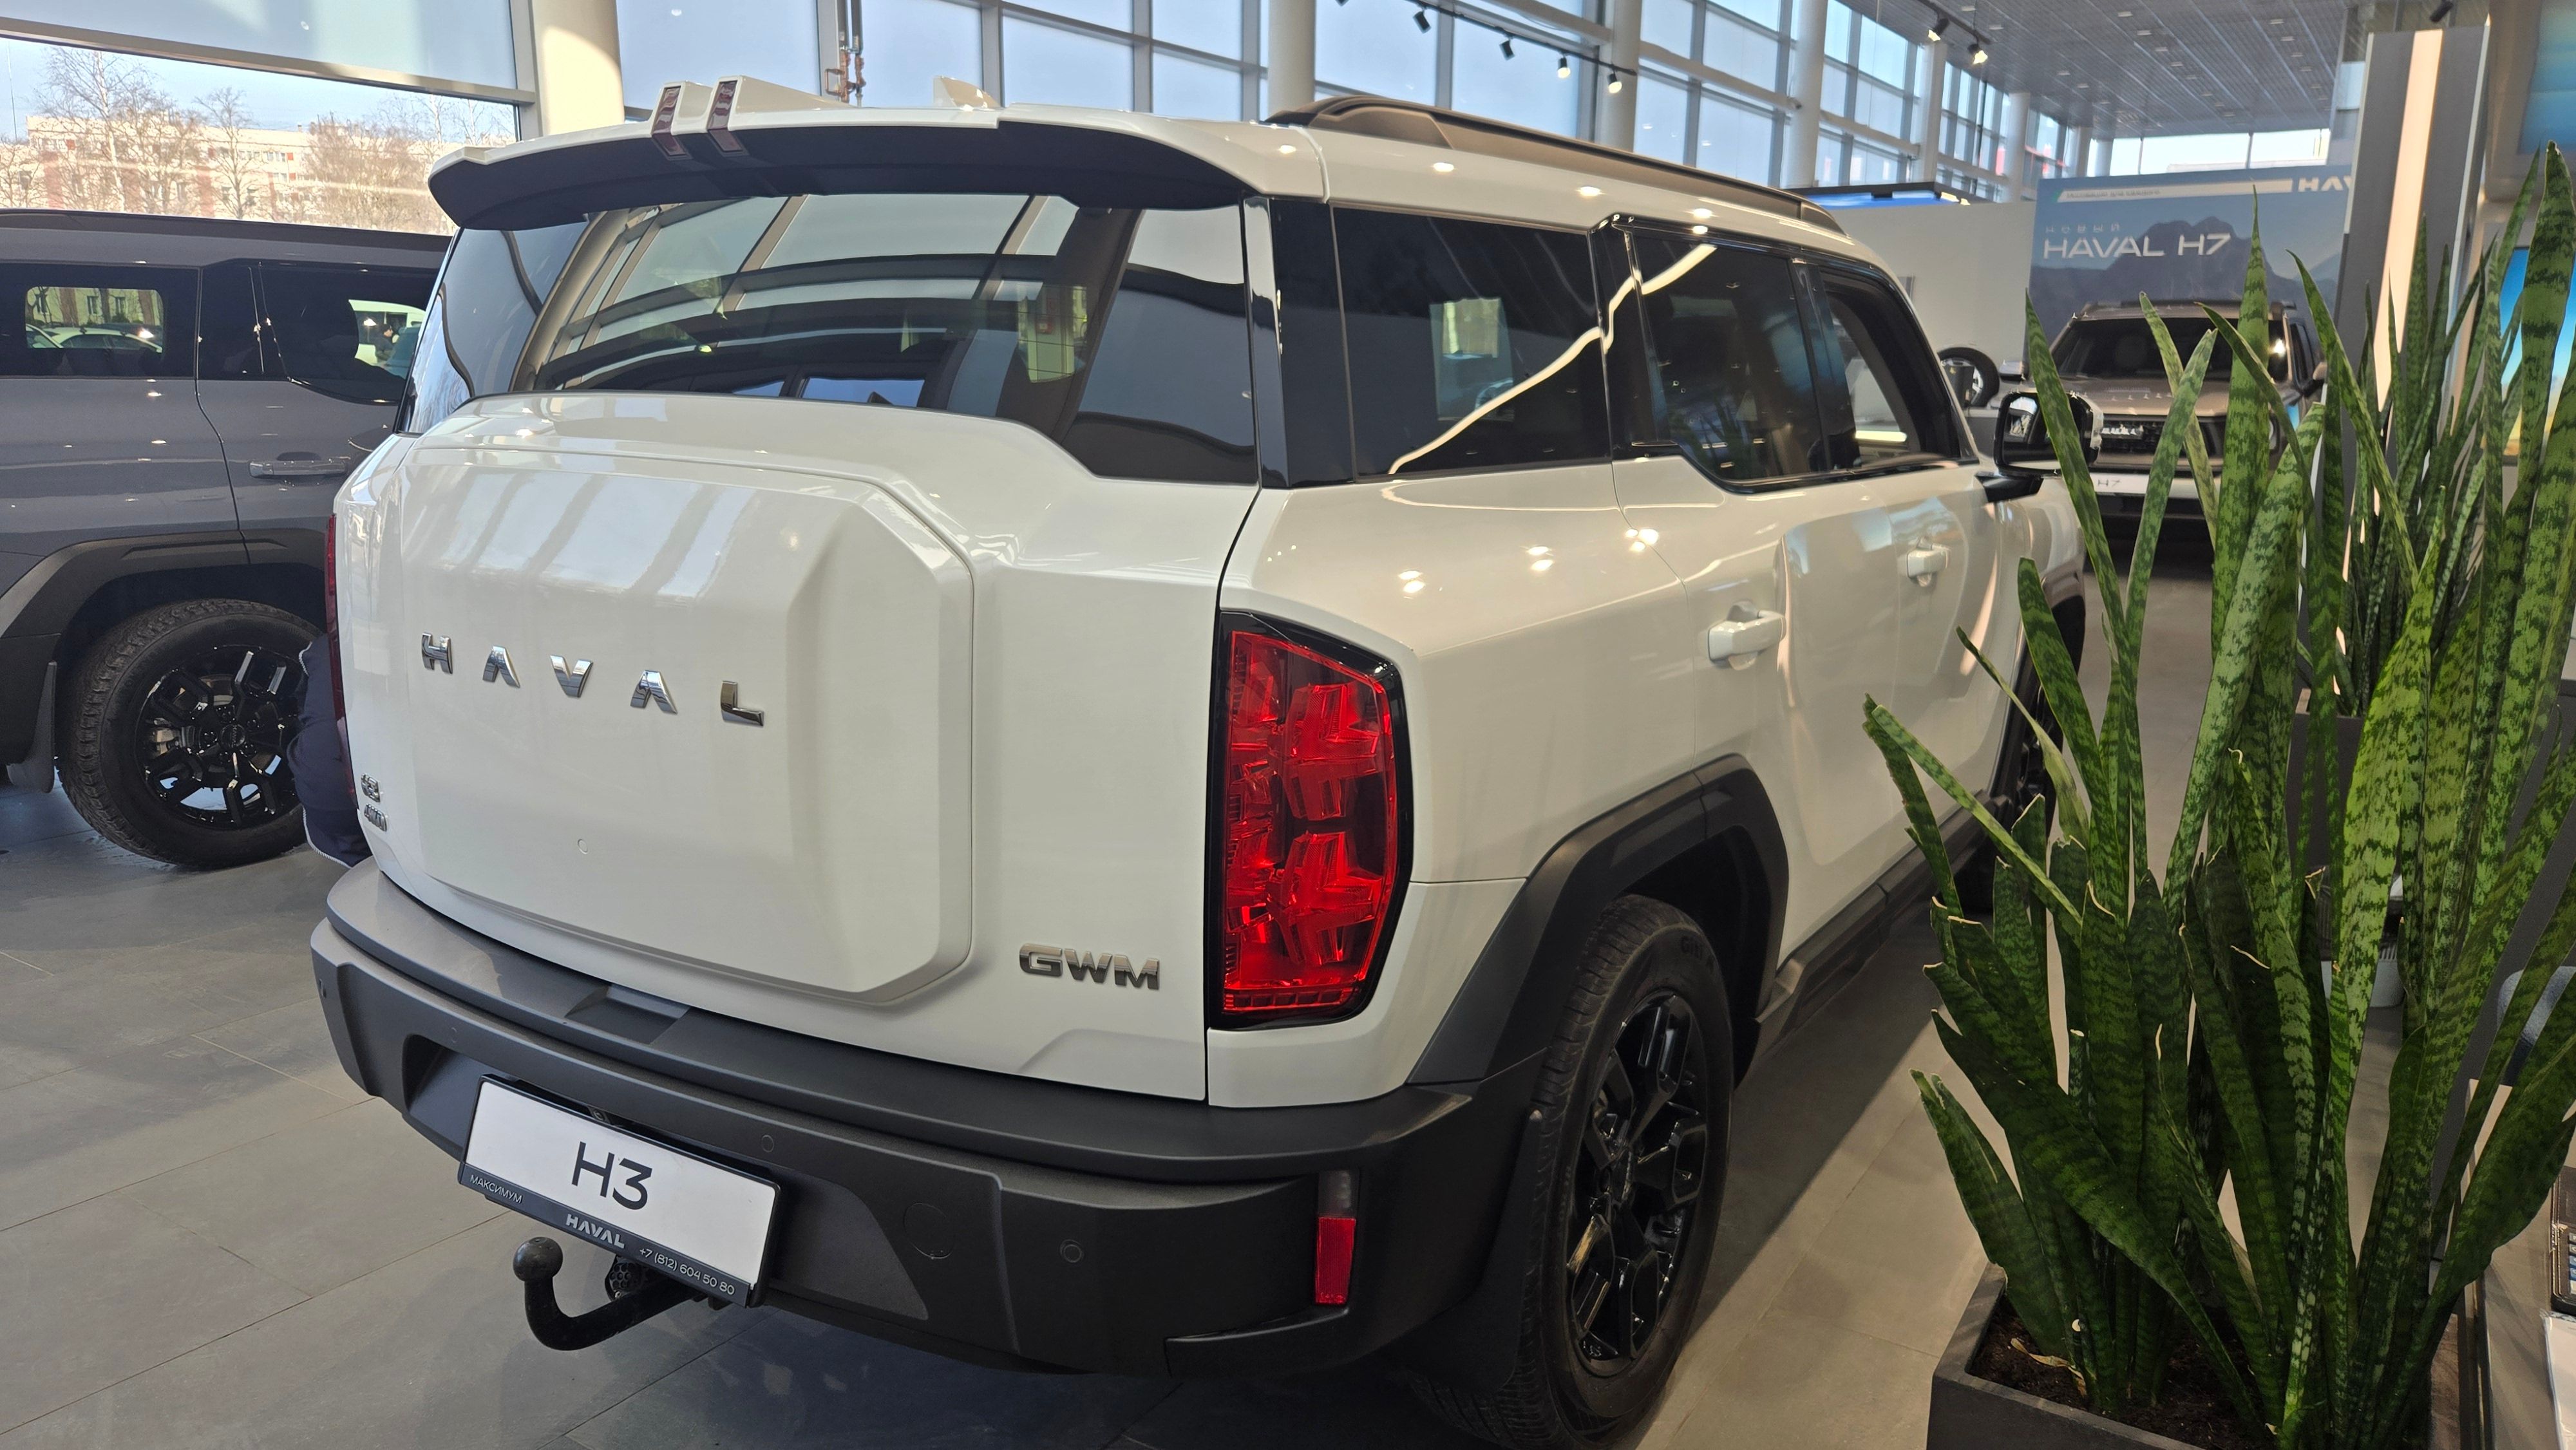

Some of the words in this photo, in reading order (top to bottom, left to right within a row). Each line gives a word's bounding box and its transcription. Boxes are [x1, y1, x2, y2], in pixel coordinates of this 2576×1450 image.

[2043, 235, 2165, 259] HAVAL
[2177, 232, 2231, 256] H7
[2098, 478, 2121, 487] H7
[421, 632, 765, 727] HAVAL
[1019, 943, 1160, 990] GWM
[470, 1174, 524, 1204] МАКСИМУМ
[571, 1141, 653, 1210] H3
[565, 1214, 626, 1249] HAVAL
[639, 1248, 653, 1258] +7
[654, 1252, 677, 1271] (812)
[679, 1264, 701, 1280] 604
[702, 1274, 717, 1287] 50
[719, 1281, 735, 1295] 80
